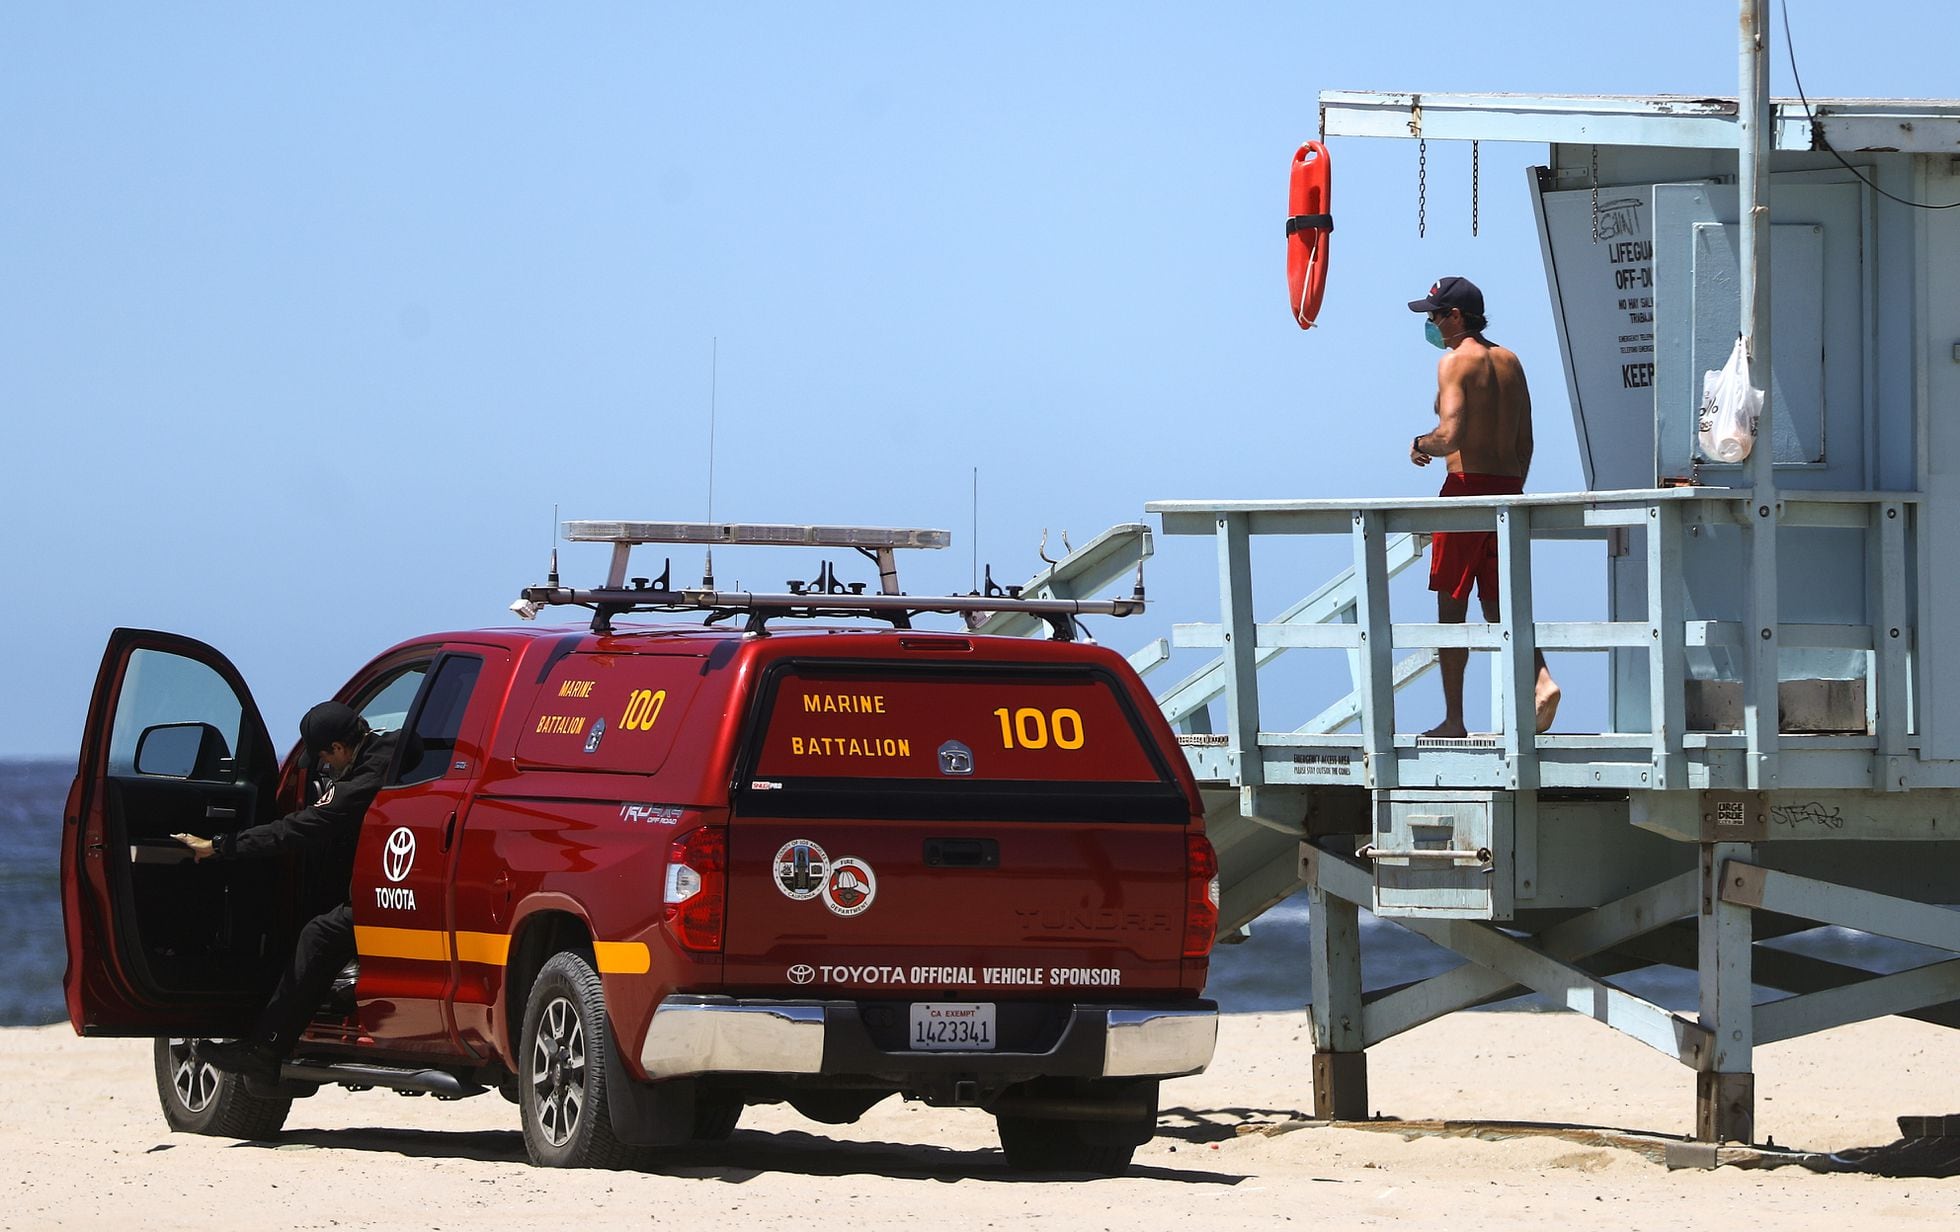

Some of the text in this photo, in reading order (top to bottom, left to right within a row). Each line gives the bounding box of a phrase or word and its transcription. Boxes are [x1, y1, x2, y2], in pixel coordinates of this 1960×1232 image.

[1622, 363, 1654, 388] KEEP
[558, 680, 596, 698] MARINE
[618, 689, 667, 731] 100
[803, 694, 886, 713] MARINE
[536, 715, 586, 735] BATTALION
[994, 707, 1085, 750] 100
[792, 737, 910, 757] BATTALION
[375, 887, 416, 910] TOYOTA
[830, 901, 868, 915] DEPARTMENT
[1015, 909, 1173, 932] TUNDRA
[820, 966, 1121, 986] TOYOTA OFFICIAL VEHICLE SPONSOR
[930, 1010, 976, 1018] CA EXEMPT
[916, 1020, 990, 1043] 1423341
